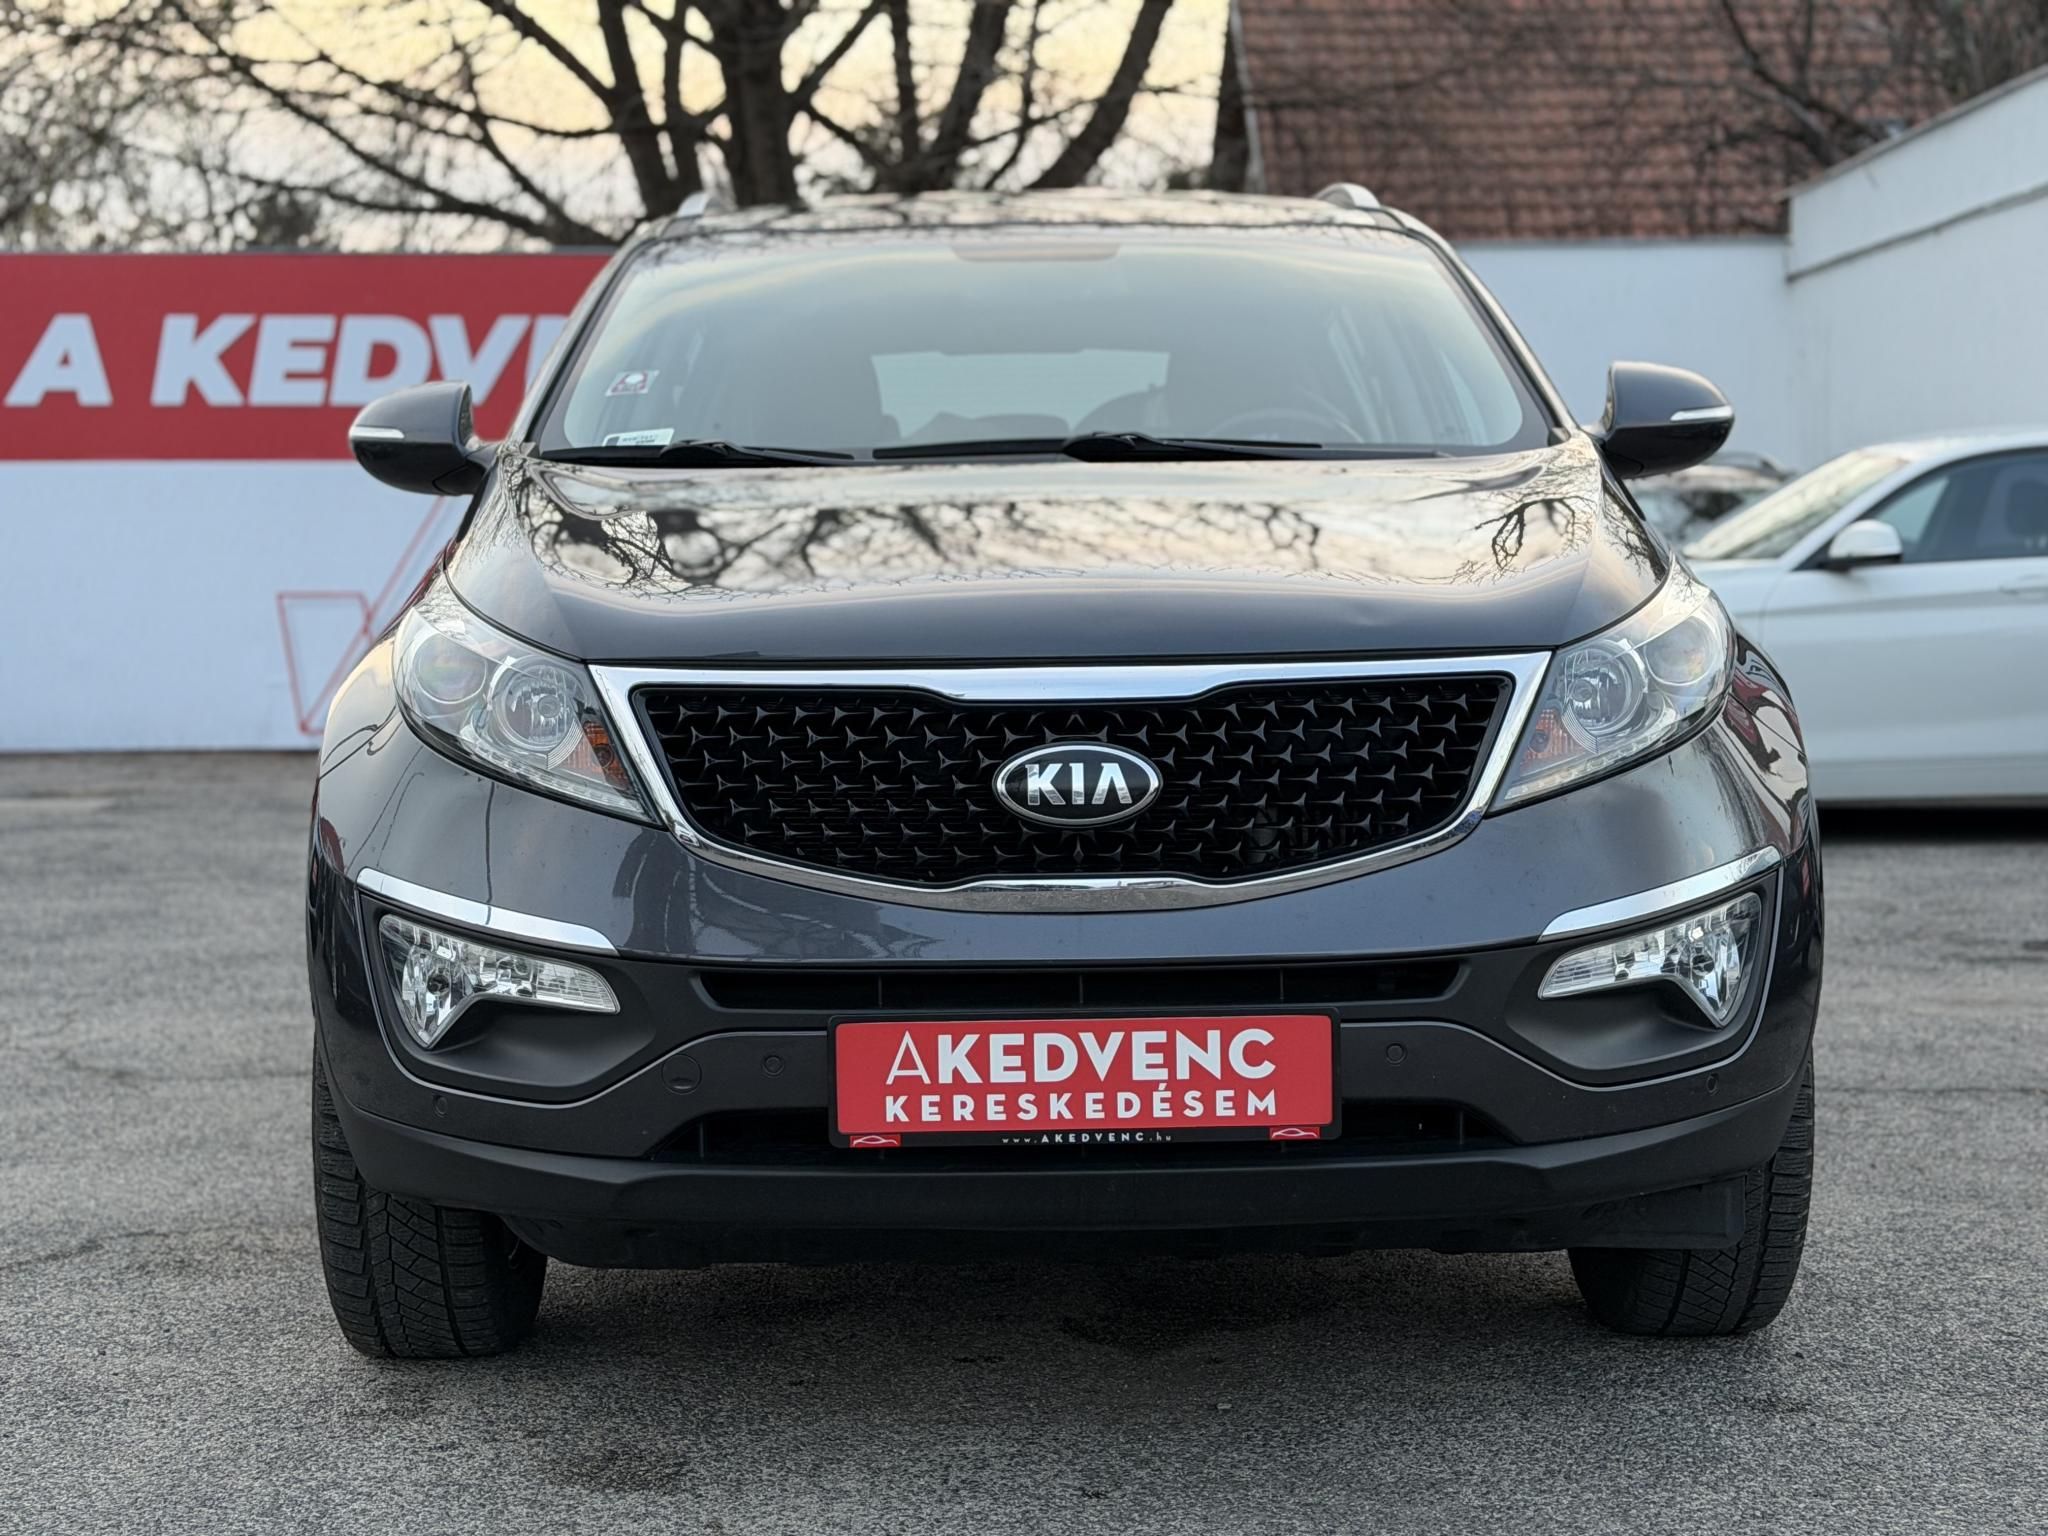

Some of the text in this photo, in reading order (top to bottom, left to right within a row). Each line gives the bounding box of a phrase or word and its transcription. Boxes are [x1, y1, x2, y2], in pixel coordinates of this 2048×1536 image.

[4, 313, 113, 407] A
[1025, 762, 1133, 806] KIA
[885, 1083, 1277, 1123] KERESKEDÉSEM
[1001, 1131, 1173, 1144] www.AKEDVENC.hu
